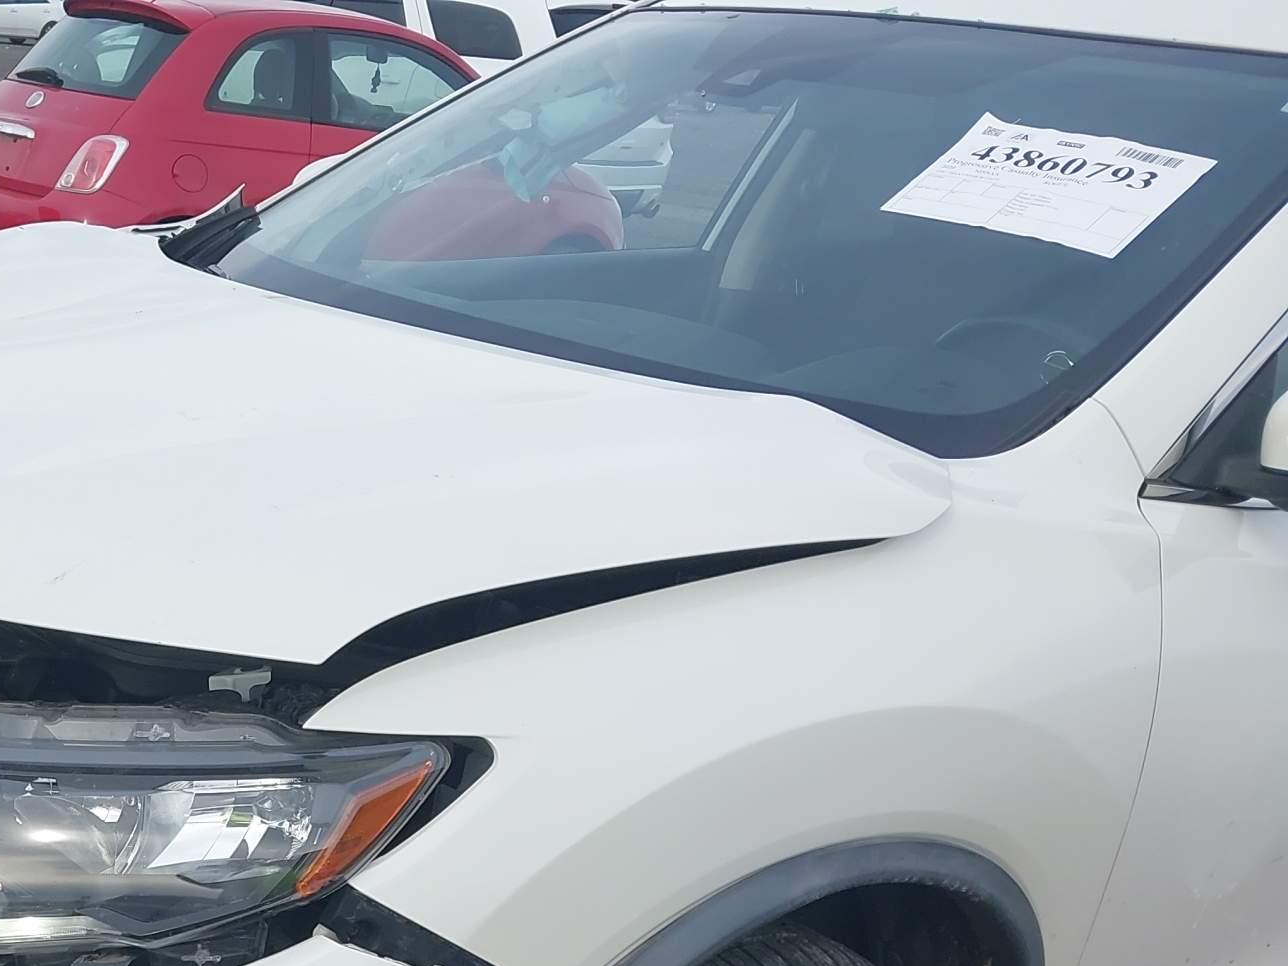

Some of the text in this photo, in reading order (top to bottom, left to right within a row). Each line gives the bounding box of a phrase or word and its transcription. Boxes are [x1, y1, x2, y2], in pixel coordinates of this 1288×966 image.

[970, 145, 1159, 190] 43860793
[1001, 165, 1043, 178] Casualty
[1043, 172, 1088, 186] Insurance
